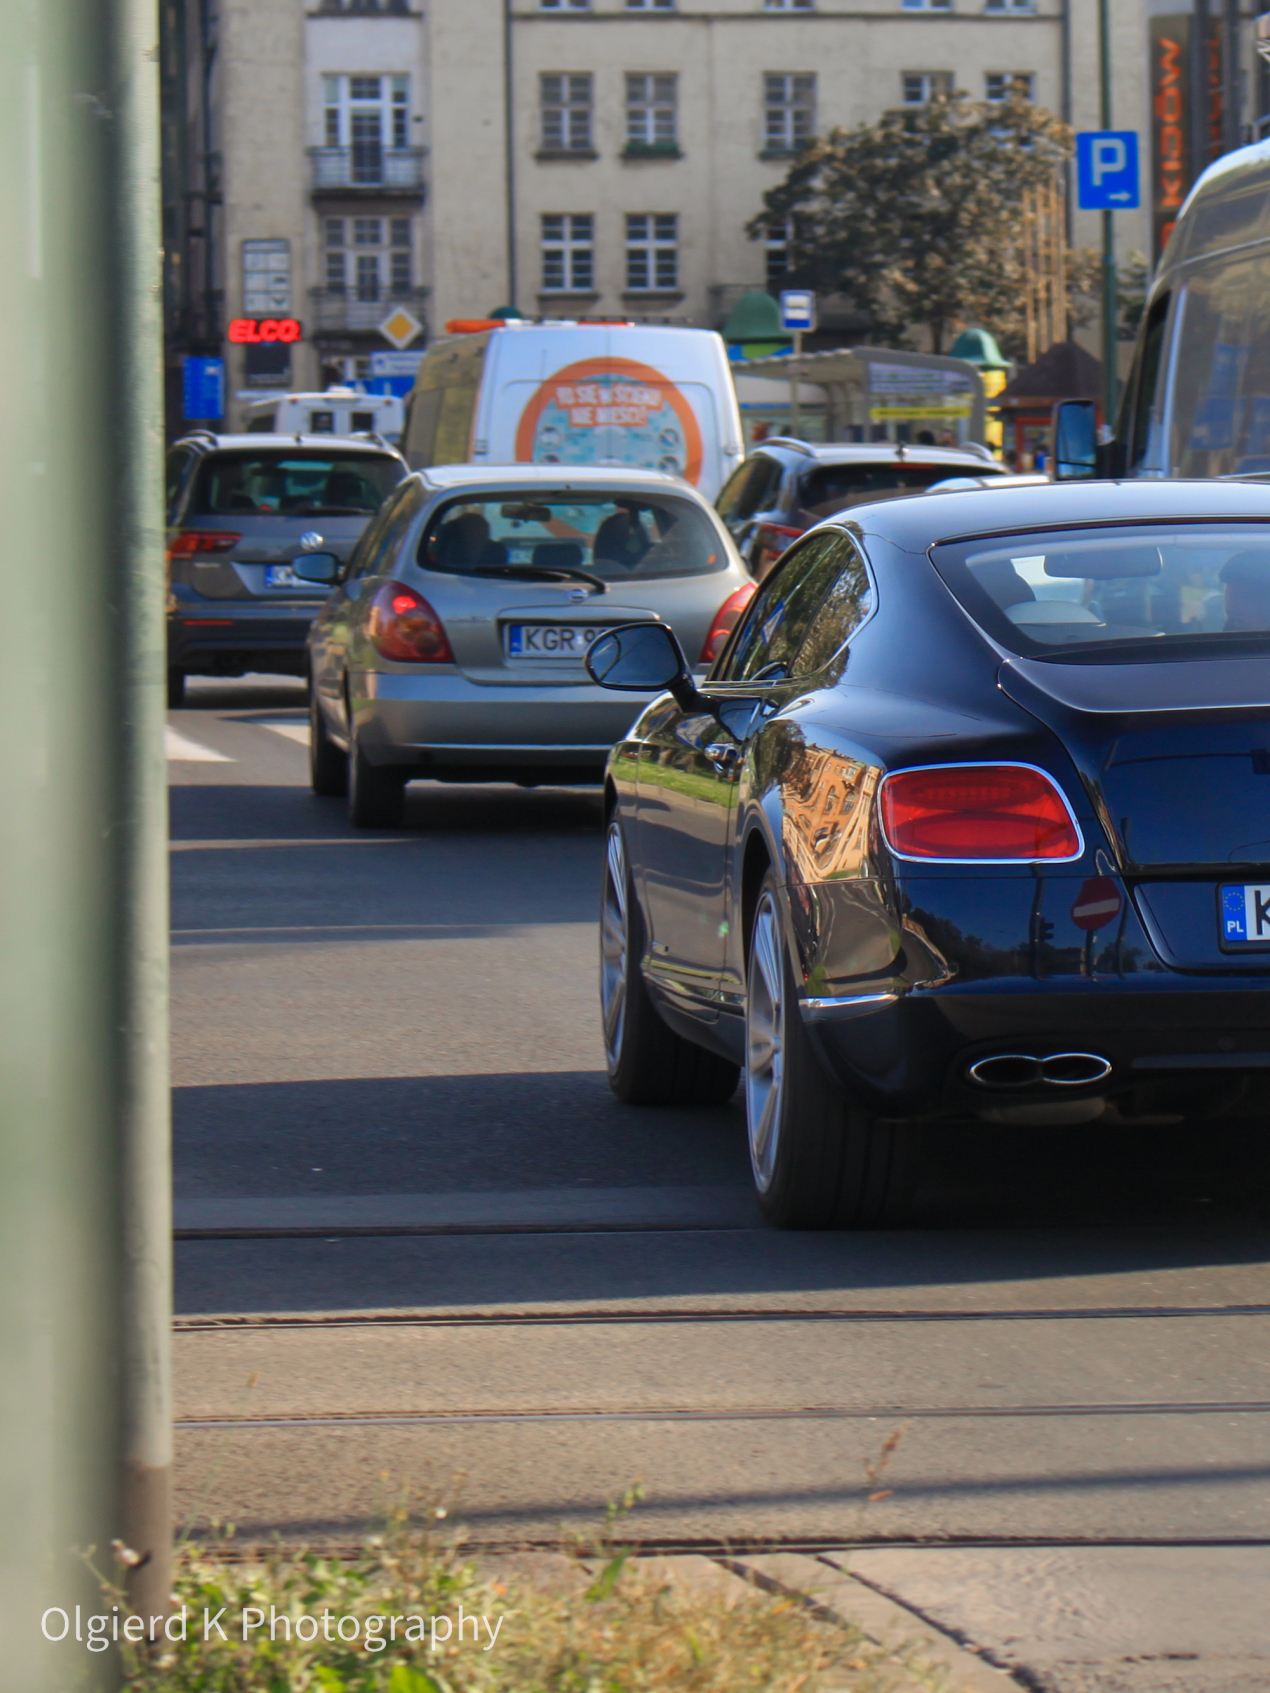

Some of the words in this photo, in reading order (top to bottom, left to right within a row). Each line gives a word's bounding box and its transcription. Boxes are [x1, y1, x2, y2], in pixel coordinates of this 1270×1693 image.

[1091, 138, 1127, 187] P
[524, 627, 575, 651] KGR
[1227, 920, 1245, 933] PL
